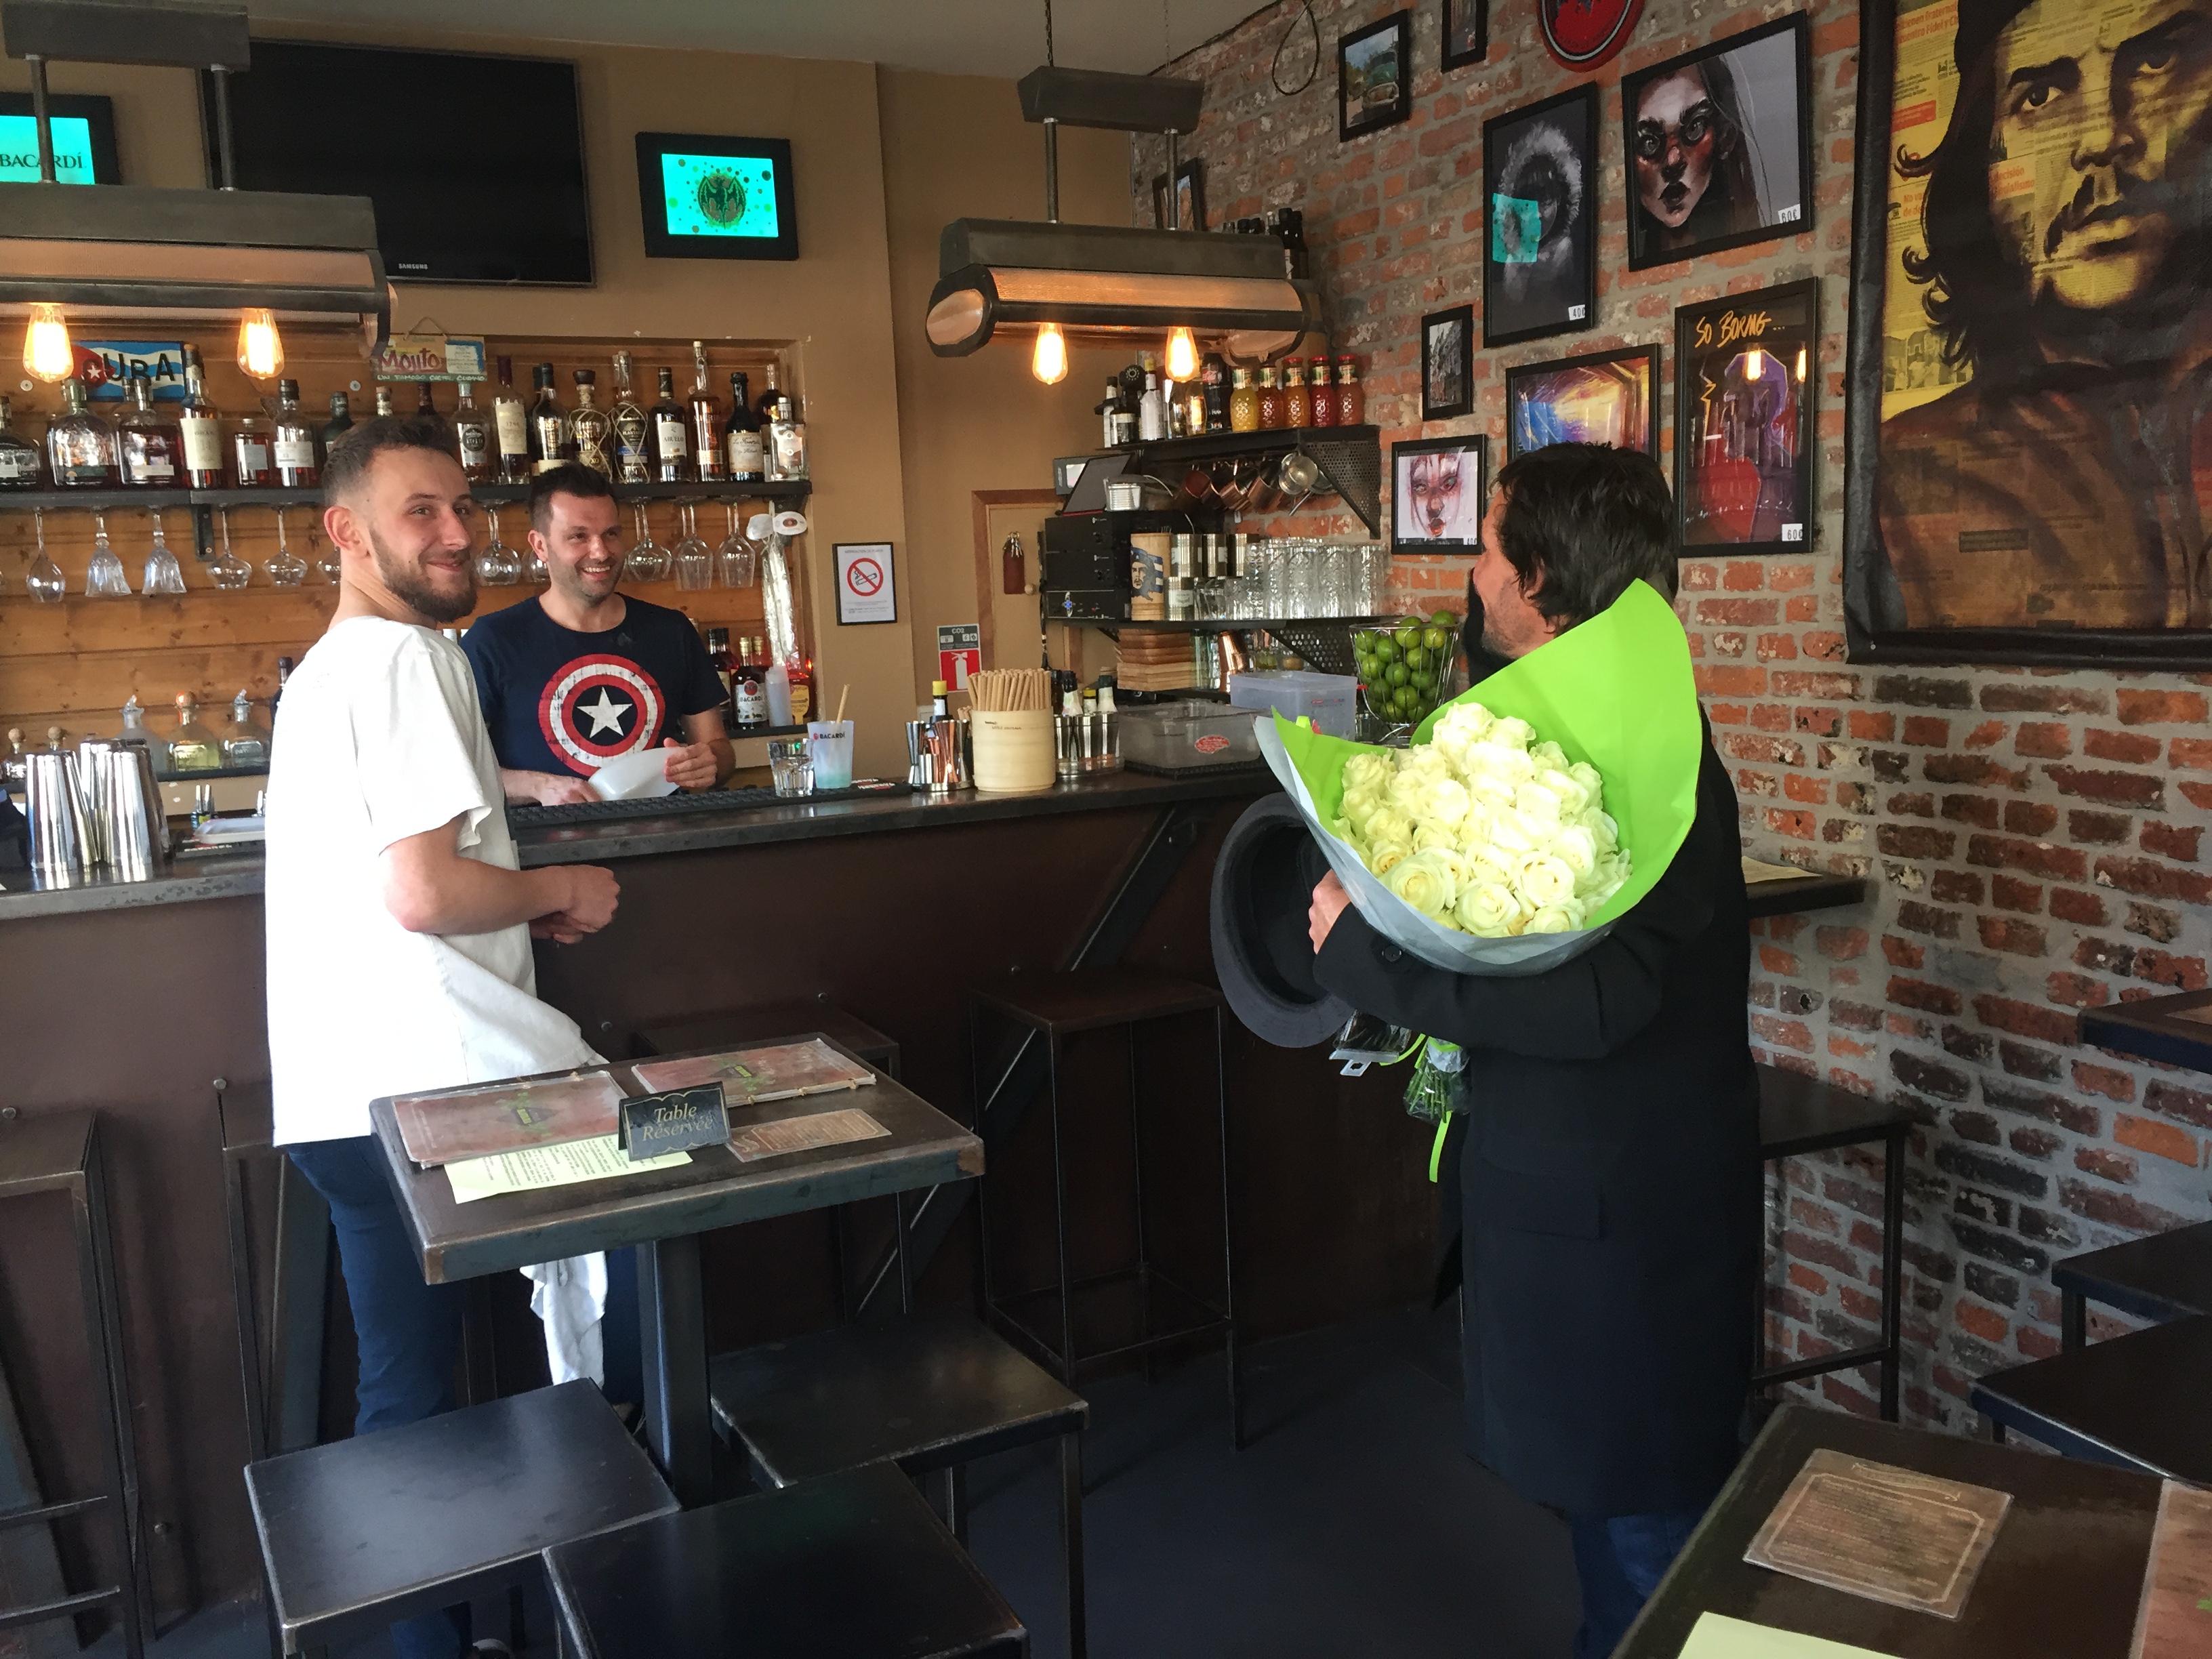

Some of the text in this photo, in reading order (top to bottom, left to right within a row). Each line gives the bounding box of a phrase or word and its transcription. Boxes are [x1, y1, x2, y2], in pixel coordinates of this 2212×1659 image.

[0, 151, 83, 169] BACRDÍ
[1781, 208, 1798, 222] 60€
[1694, 316, 1712, 348] SO
[654, 1103, 697, 1124] Table
[642, 1115, 714, 1142] Réservée
